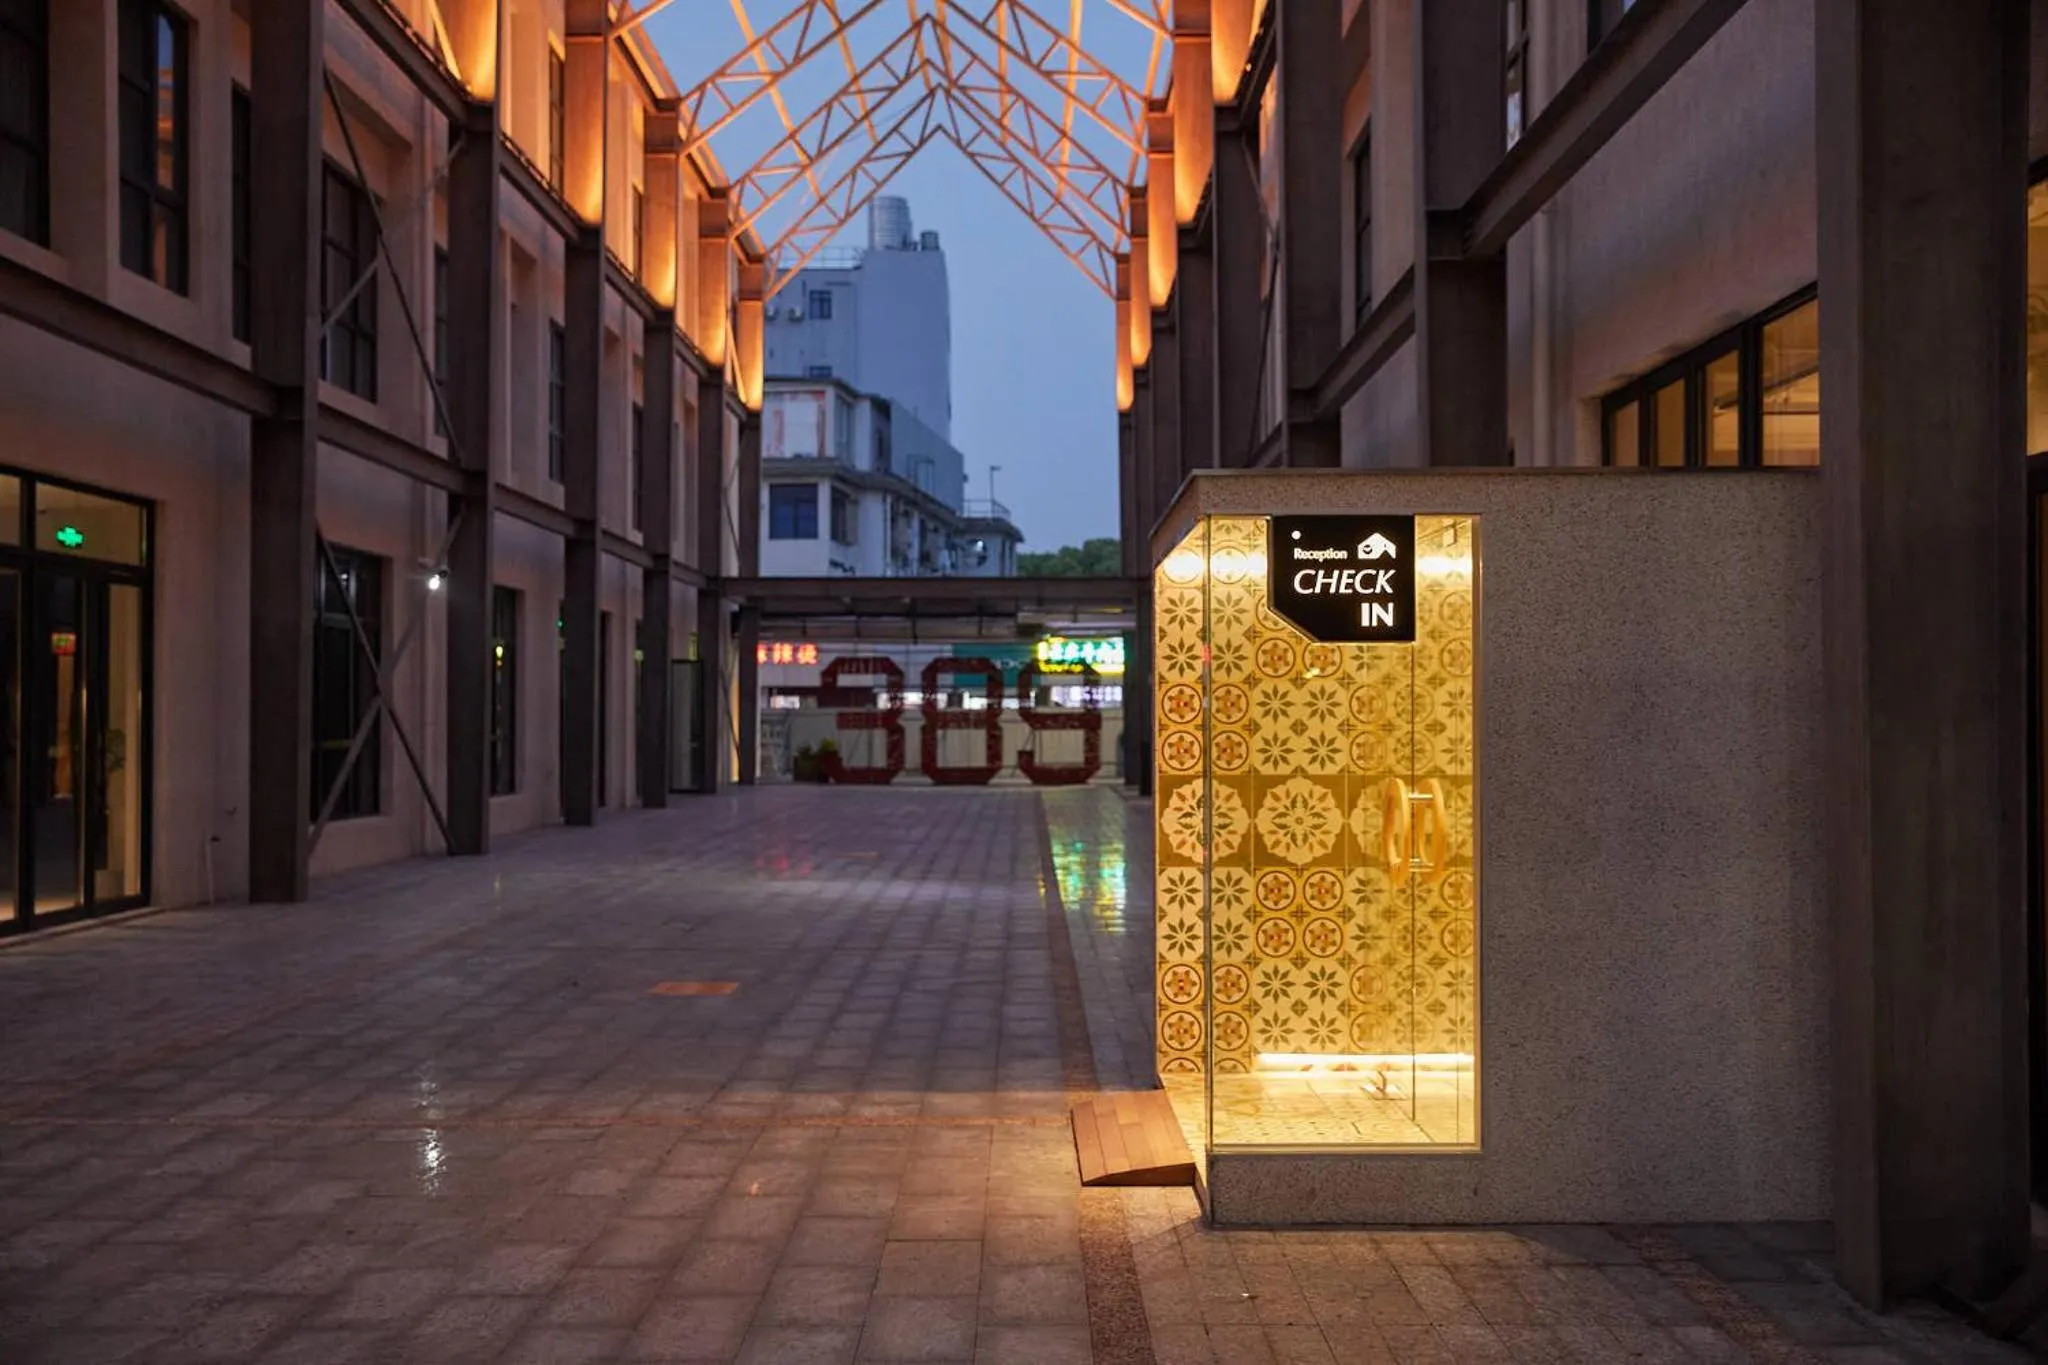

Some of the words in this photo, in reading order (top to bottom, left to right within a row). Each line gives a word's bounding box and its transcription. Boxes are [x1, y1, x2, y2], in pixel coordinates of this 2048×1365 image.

[1293, 548, 1348, 562] Reception
[1293, 569, 1396, 594] CHECK
[1361, 602, 1394, 627] IN
[819, 656, 1102, 785] 389
